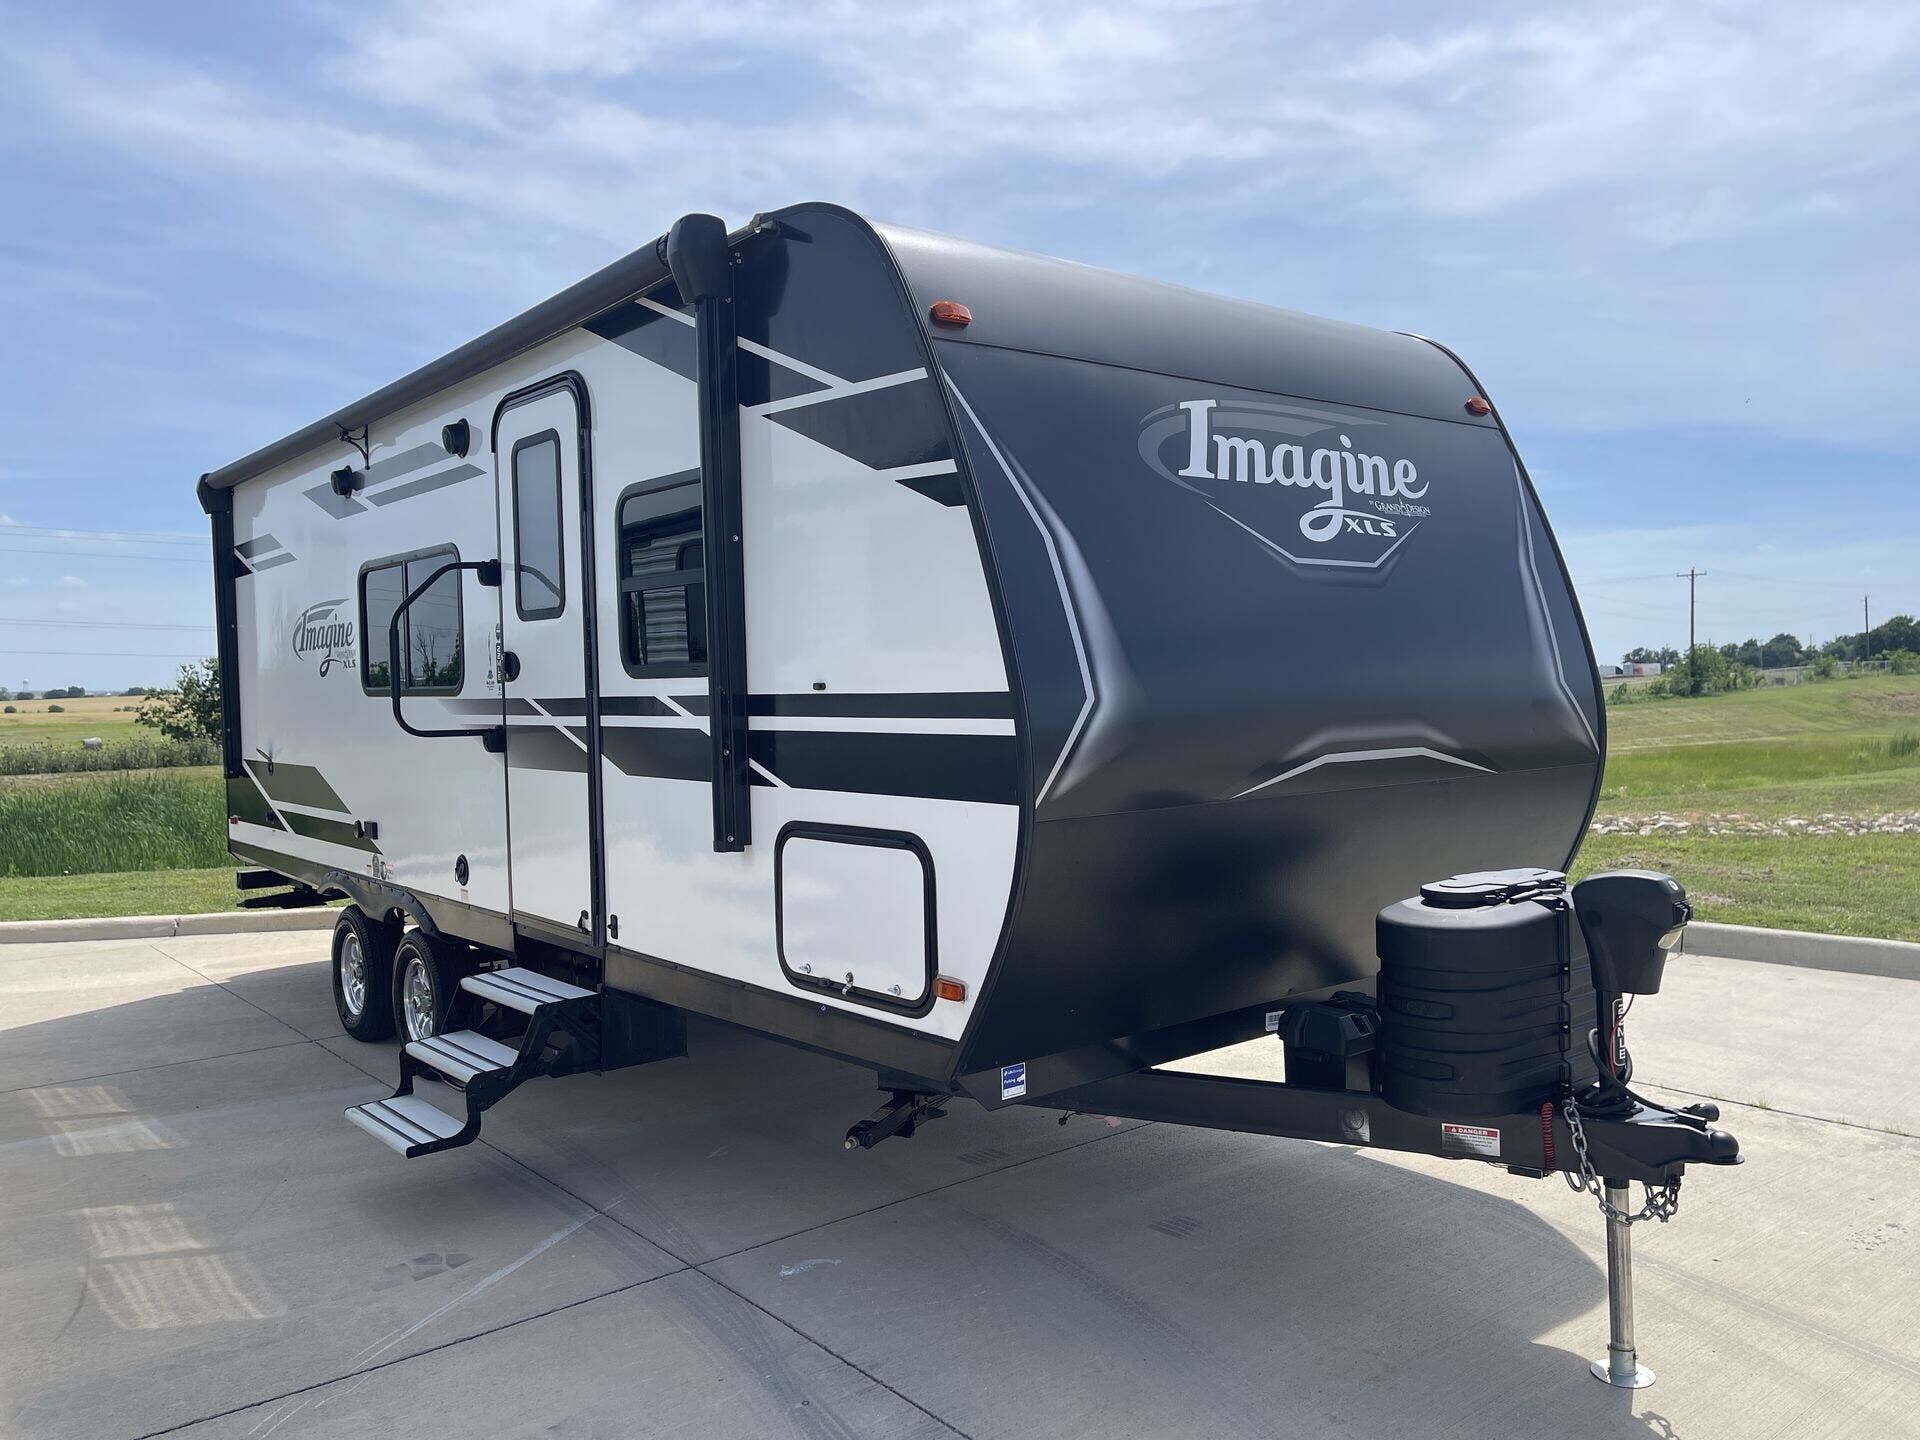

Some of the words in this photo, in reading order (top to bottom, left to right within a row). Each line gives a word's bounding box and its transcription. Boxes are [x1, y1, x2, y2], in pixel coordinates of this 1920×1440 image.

[1178, 399, 1430, 542] Imagine
[1374, 500, 1400, 511] GRAND
[1404, 503, 1431, 514] DESIGN
[1343, 517, 1397, 538] XLS
[298, 608, 355, 678] Imagine
[342, 659, 356, 669] XLS
[1457, 1127, 1488, 1136] DANGER
